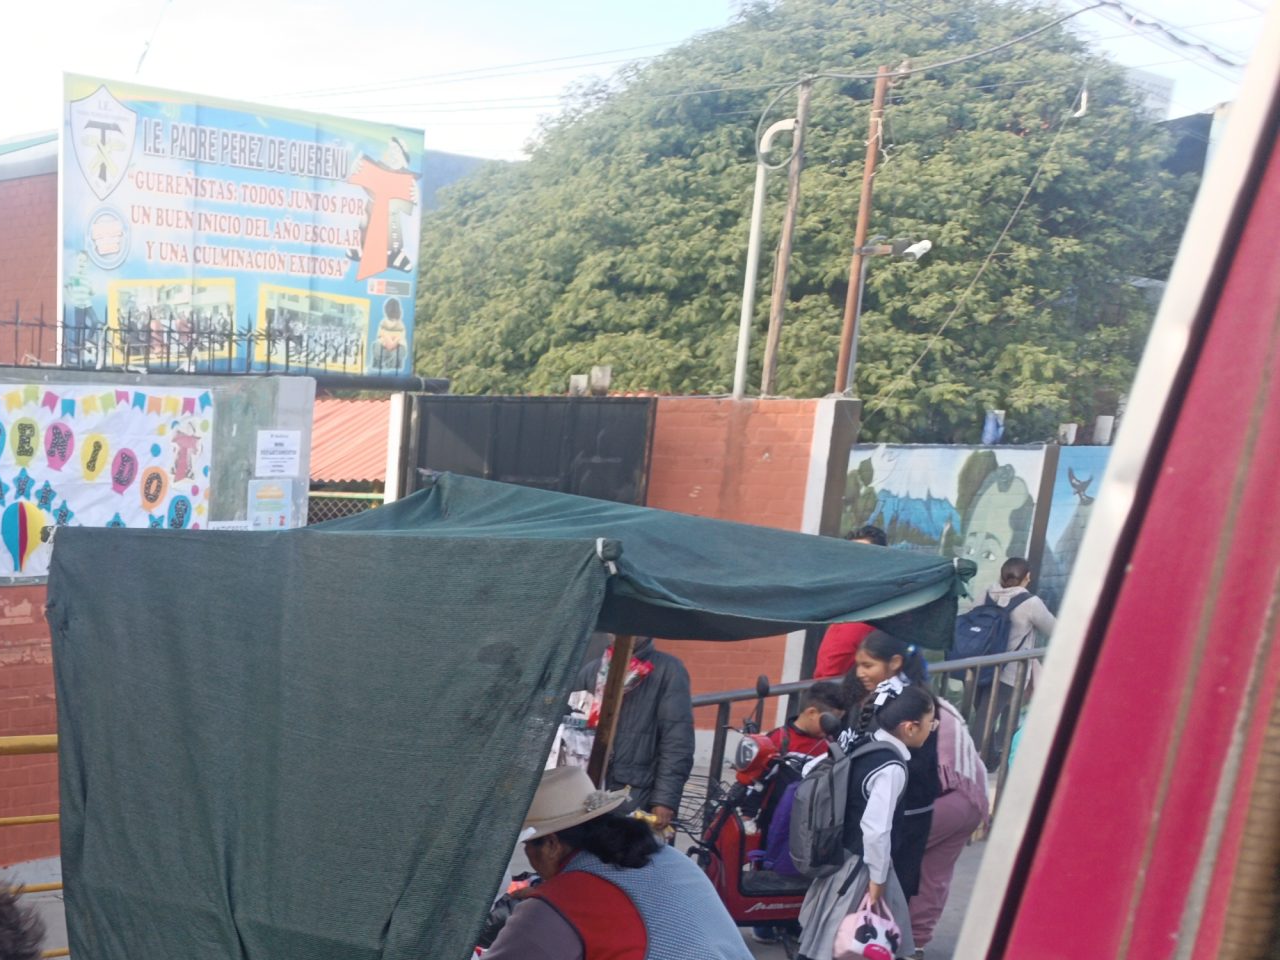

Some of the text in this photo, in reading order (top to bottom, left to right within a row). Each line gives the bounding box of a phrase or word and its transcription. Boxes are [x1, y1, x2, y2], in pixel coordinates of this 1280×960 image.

[143, 120, 166, 154] I.E.
[170, 124, 217, 161] PADRE
[221, 132, 263, 168] PEREZ
[267, 139, 287, 171] DE
[241, 184, 284, 206] TODOS
[287, 190, 337, 213] JUNTOS
[341, 196, 365, 216] POR
[131, 205, 359, 247] UN BUEN INICIO DEL AÑO ESCOLAR
[146, 240, 156, 260] Y
[160, 242, 189, 263] UNA
[193, 246, 286, 272] CULMINACIÓN
